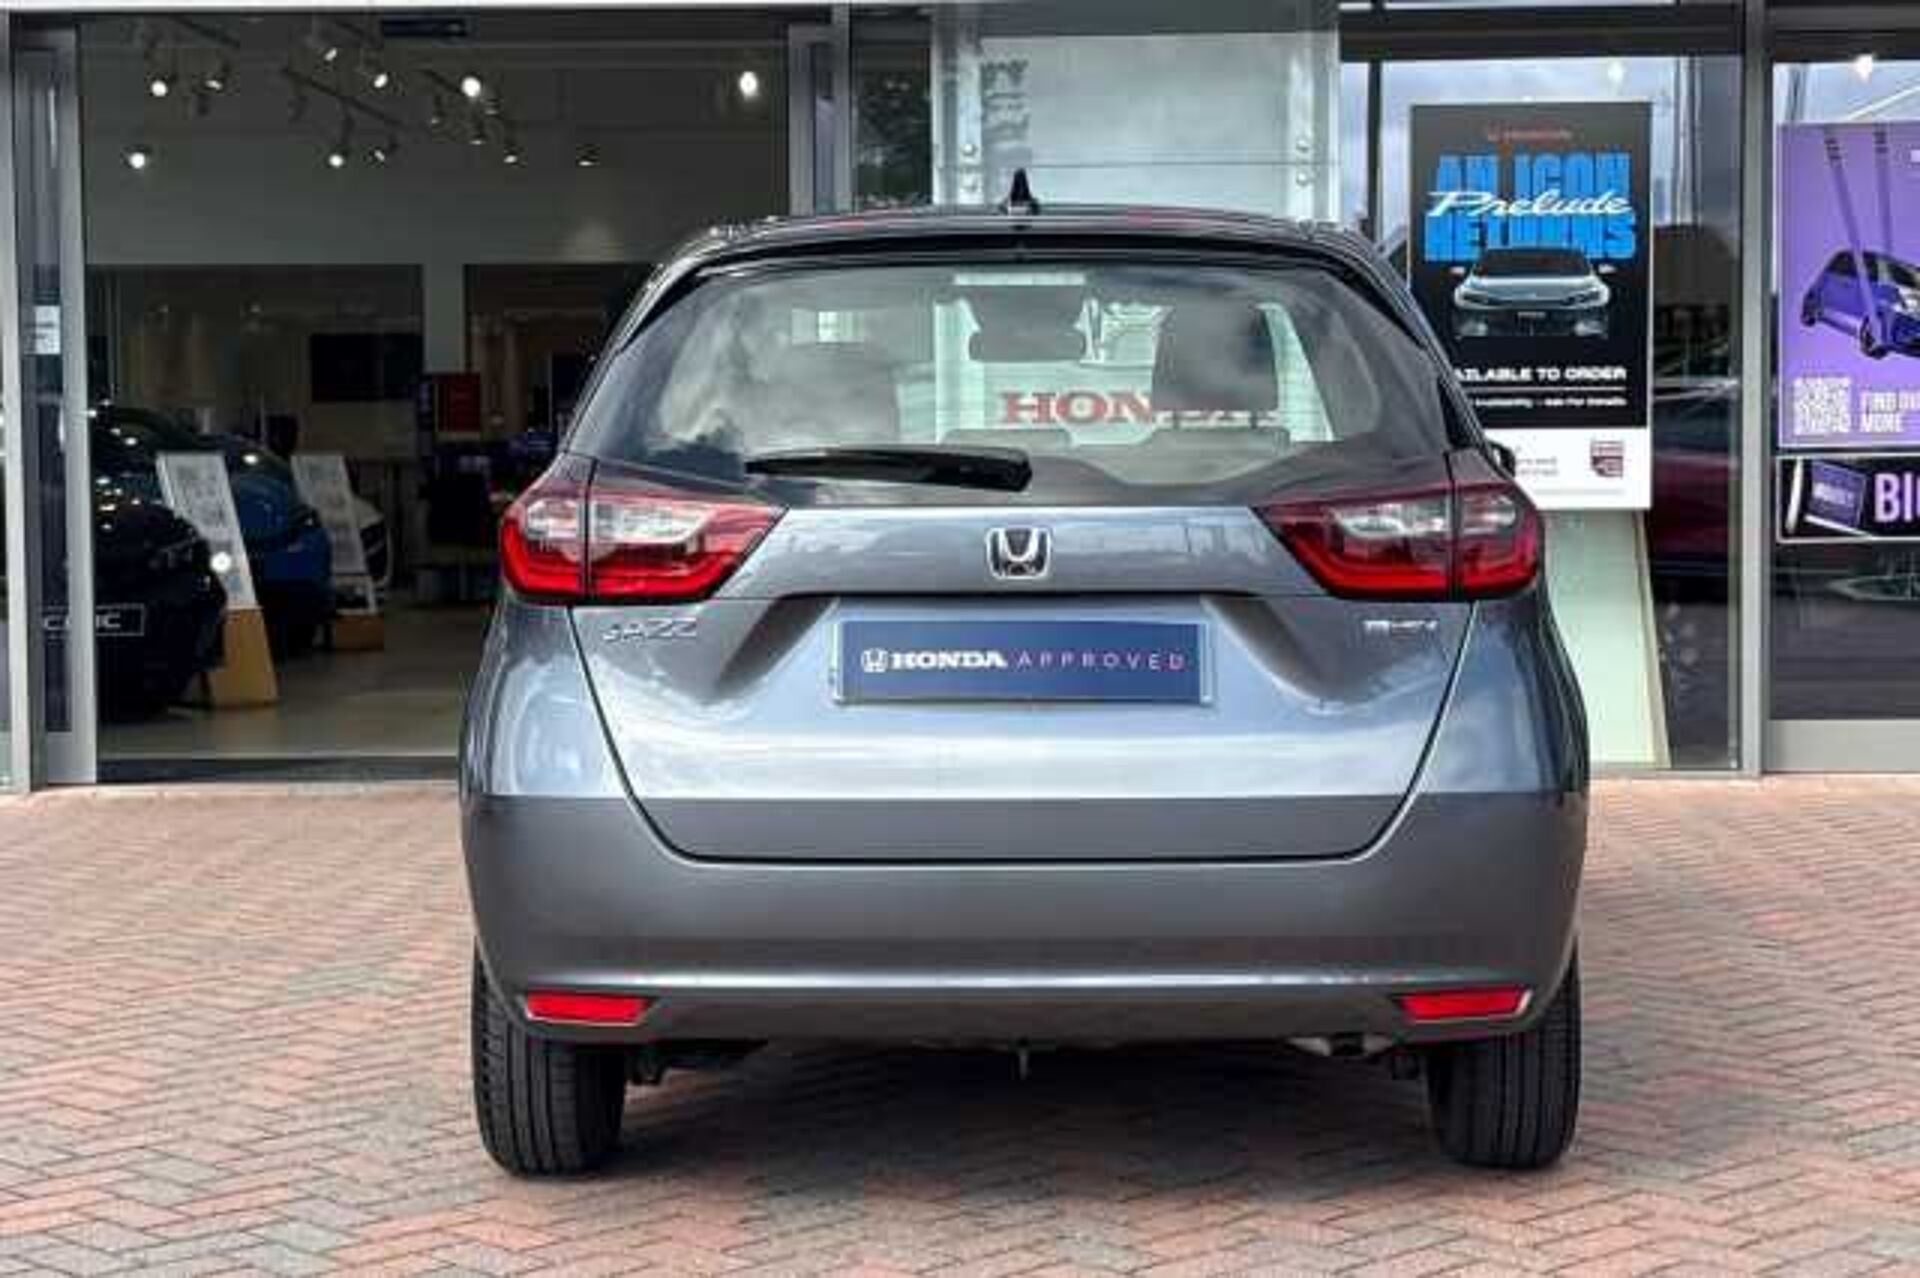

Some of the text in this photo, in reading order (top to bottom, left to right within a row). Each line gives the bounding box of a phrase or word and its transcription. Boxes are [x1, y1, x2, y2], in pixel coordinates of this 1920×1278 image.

[1426, 188, 1632, 217] Prelude
[1536, 367, 1561, 381] TO
[1564, 366, 1627, 381] ORDER
[1874, 472, 1920, 523] BI
[893, 650, 1185, 670] HONDA APPROVED
